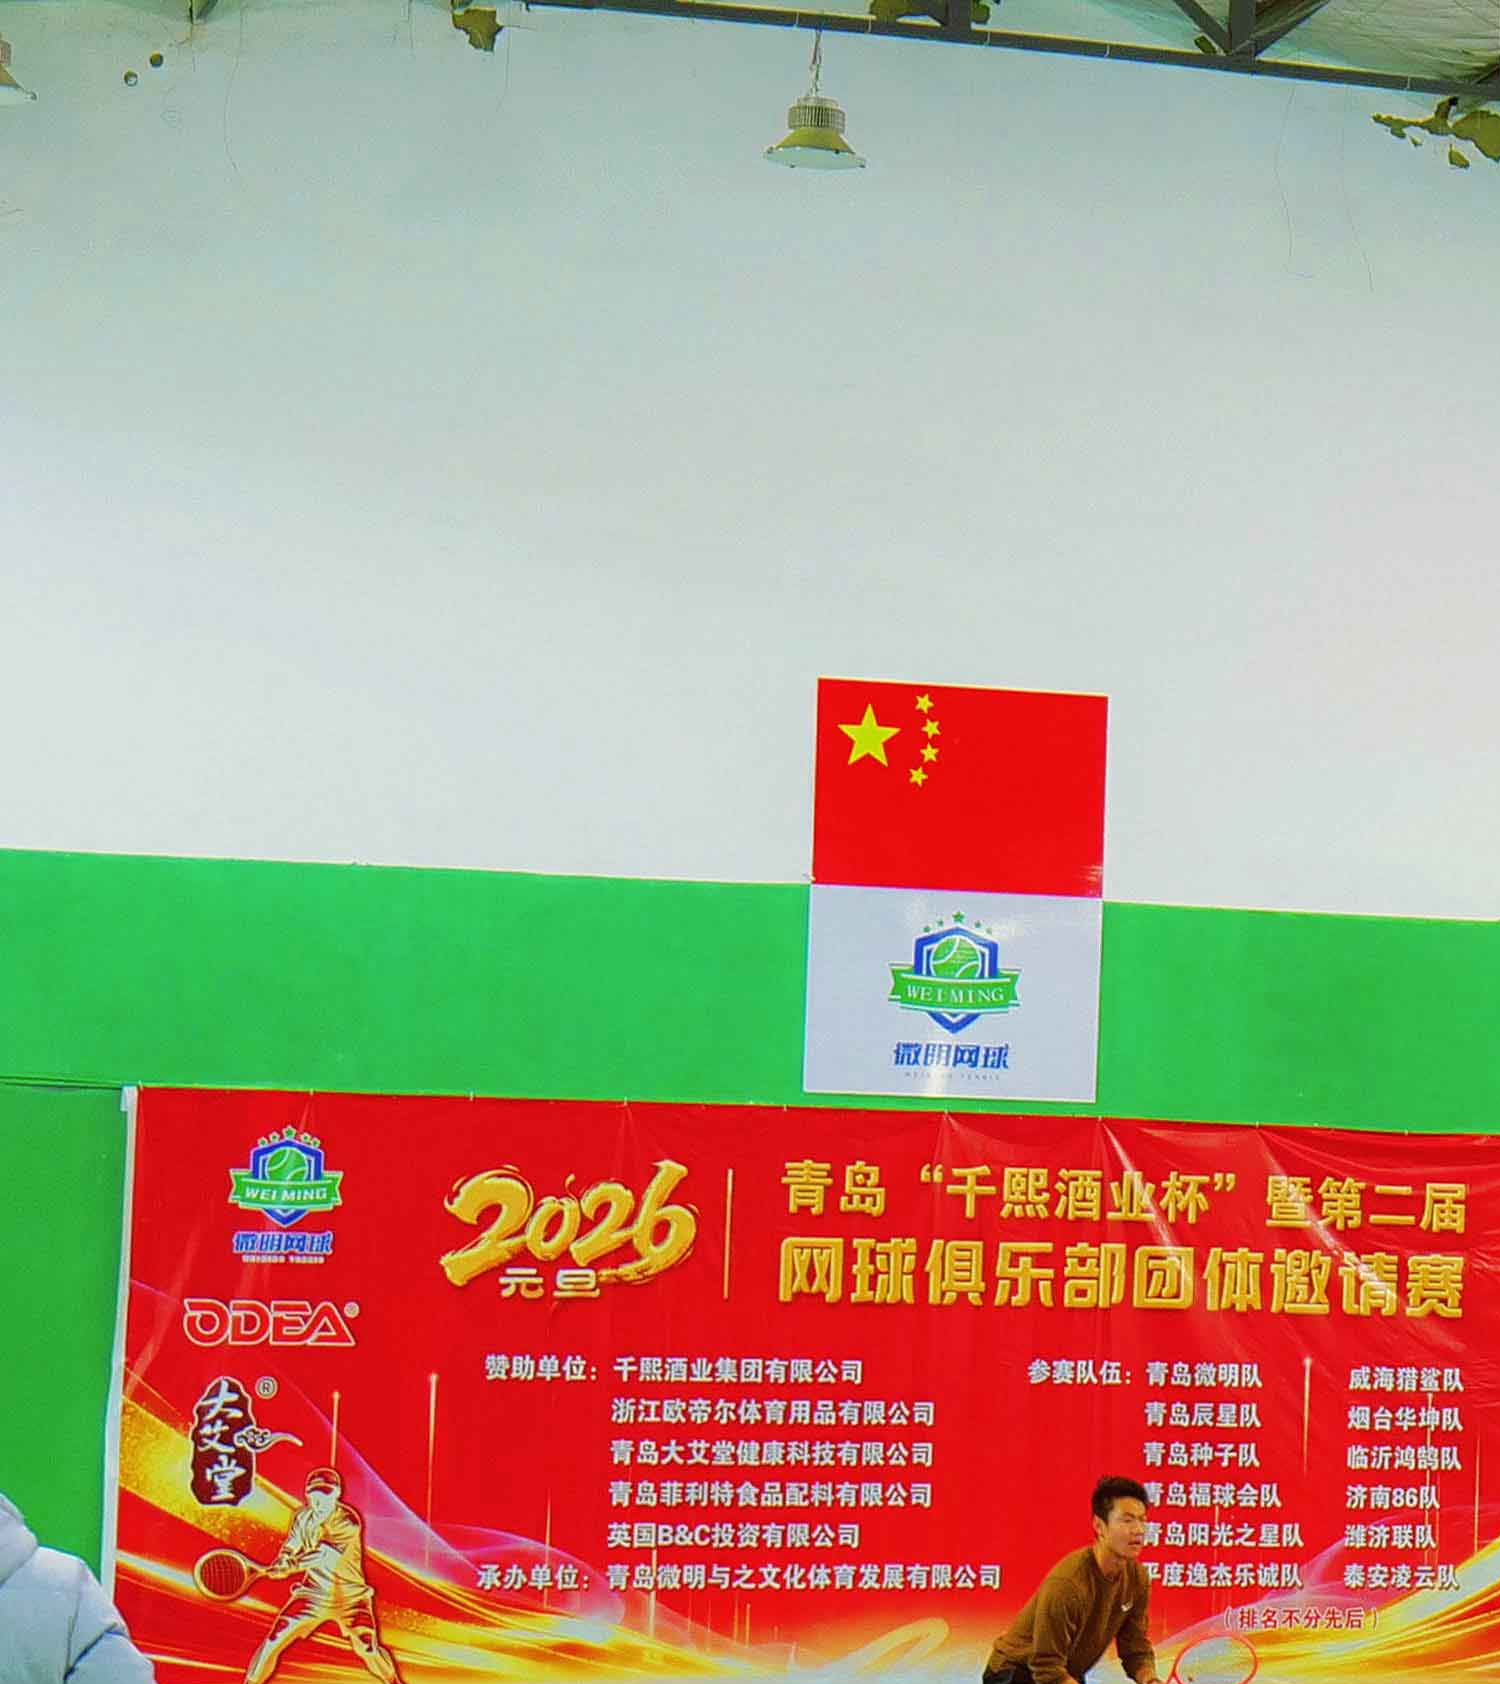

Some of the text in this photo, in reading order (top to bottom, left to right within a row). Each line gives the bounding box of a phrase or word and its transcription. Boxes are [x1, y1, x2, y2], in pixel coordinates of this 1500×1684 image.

[440, 1159, 699, 1288] 2026
[499, 1267, 601, 1299] 元旦
[778, 1238, 1465, 1318] 网球俱乐部团体邀请赛
[183, 1298, 356, 1346] ODEA
[1348, 1365, 1464, 1392] 威海猎鲨队
[611, 1398, 936, 1426] 浙江欧帝尔体育用品有限公司
[1145, 1401, 1262, 1429] 青岛辰星队
[1347, 1405, 1464, 1432] 烟台华坤队
[197, 1379, 247, 1500] 大艾堂
[609, 1439, 934, 1467] 青岛大艾堂健康科技有限公司
[1143, 1441, 1261, 1469] 青岛种子队
[608, 1480, 933, 1509] 青岛菲利特食品配料有限公司
[1143, 1481, 1282, 1508] 青岛福球会队
[1345, 1484, 1440, 1509] 济南86队
[607, 1522, 861, 1549] 英国B&C投资有限公司
[1143, 1521, 1305, 1548] 青岛阳光之星队
[1343, 1563, 1460, 1590] 泰安凌云队
